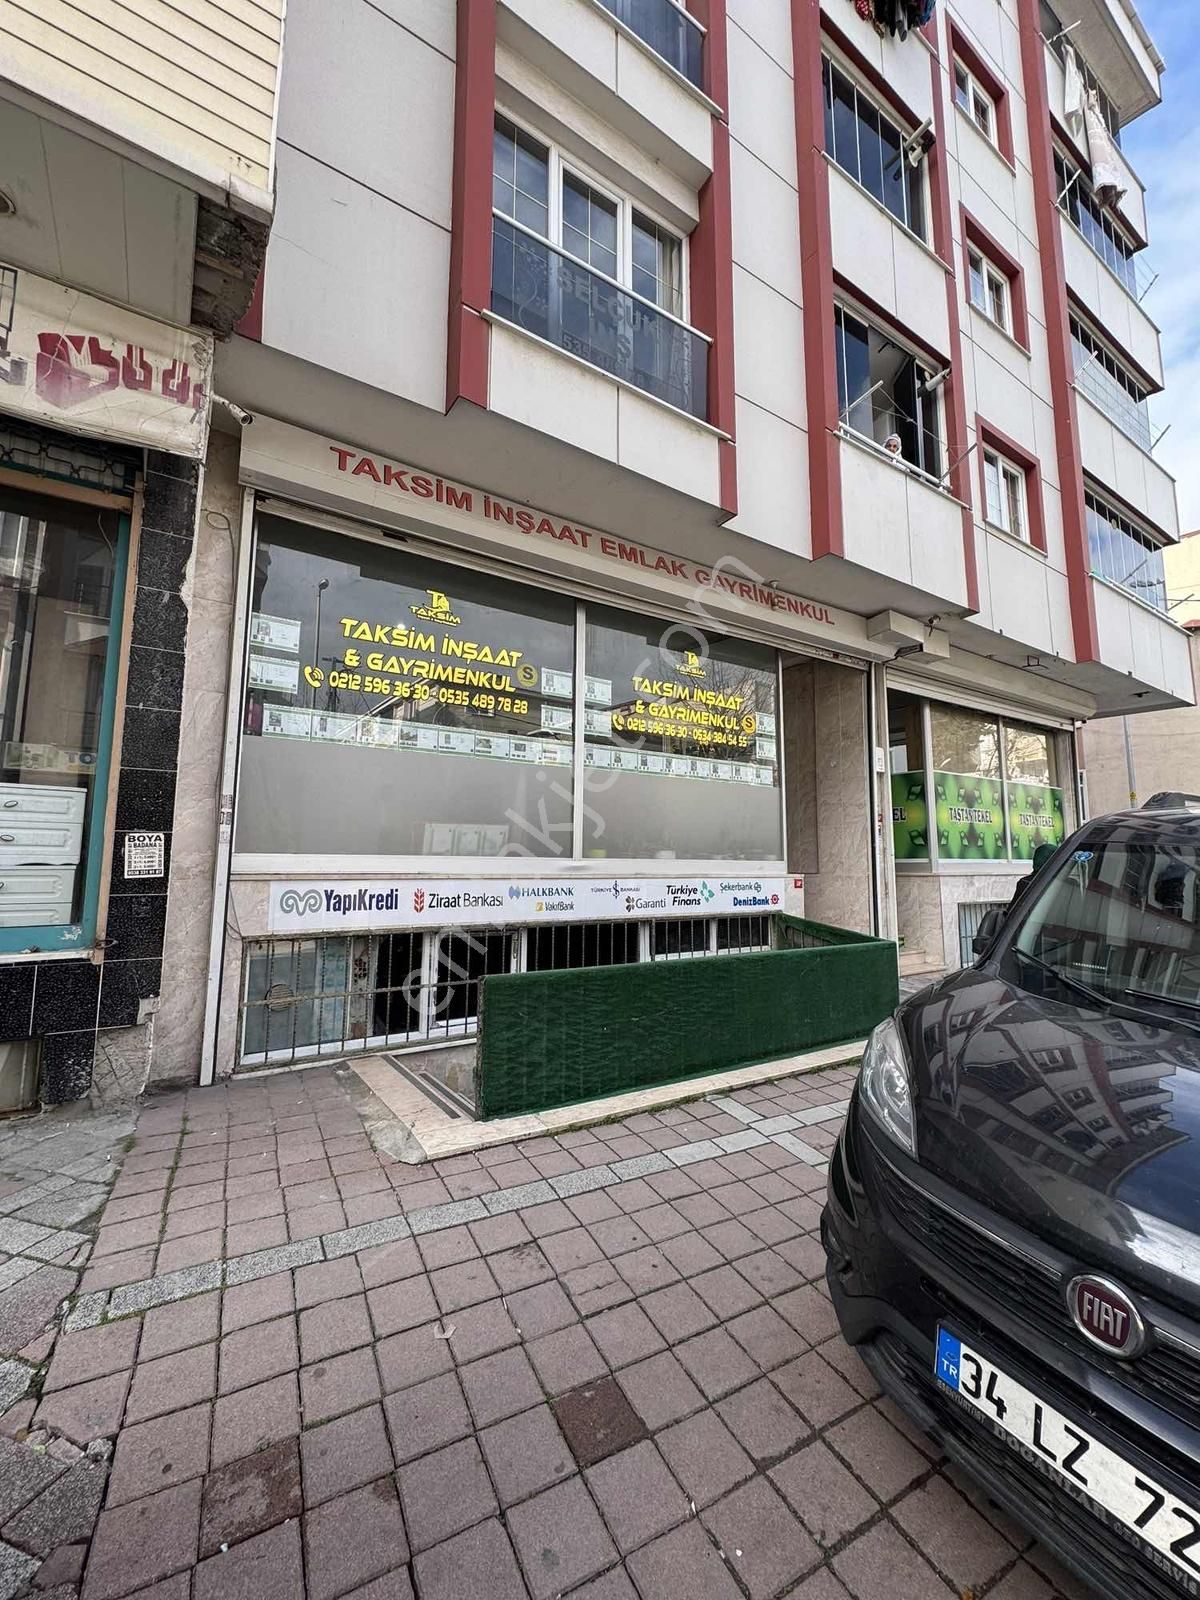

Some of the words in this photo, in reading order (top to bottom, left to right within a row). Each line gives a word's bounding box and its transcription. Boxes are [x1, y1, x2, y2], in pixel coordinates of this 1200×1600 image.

[330, 446, 473, 513] TAKSİM
[484, 495, 593, 549] İNŞAAT
[601, 537, 689, 580] EMLAK
[340, 617, 436, 653] TAKSİM
[442, 633, 523, 668] İNŞAAT
[344, 648, 361, 668] &
[366, 652, 517, 693] GAYRİMENKUL
[328, 670, 361, 691] 0212
[364, 676, 391, 696] 596
[392, 681, 411, 698] 36
[412, 685, 431, 701] 30
[439, 690, 470, 707] 0535
[471, 694, 496, 711] 489
[497, 698, 512, 714] 78
[513, 699, 529, 715] 28
[631, 676, 690, 701] TAKSİM
[694, 684, 745, 711] İNŞAAT
[635, 699, 646, 715] &
[648, 702, 741, 731] GAYRİMENKUL
[627, 717, 647, 732] 0212
[648, 723, 664, 736] 596
[678, 726, 688, 739] 30
[128, 834, 162, 843] BOYA
[521, 886, 575, 898] HALKBANK
[666, 885, 699, 898] Türkiye
[720, 882, 753, 893] Şekerbank
[324, 888, 400, 915] YapıKredi
[428, 893, 461, 909] Ziraat
[463, 892, 504, 908] Bankası
[635, 897, 667, 910] Garanti
[672, 895, 702, 907] Finans
[733, 896, 770, 907] DenizBank
[1082, 1290, 1128, 1341] FIAT
[941, 1358, 958, 1380] TR
[961, 1353, 1008, 1421] 34
[1033, 1402, 1090, 1488] LZ
[1133, 1475, 1200, 1573] 72
